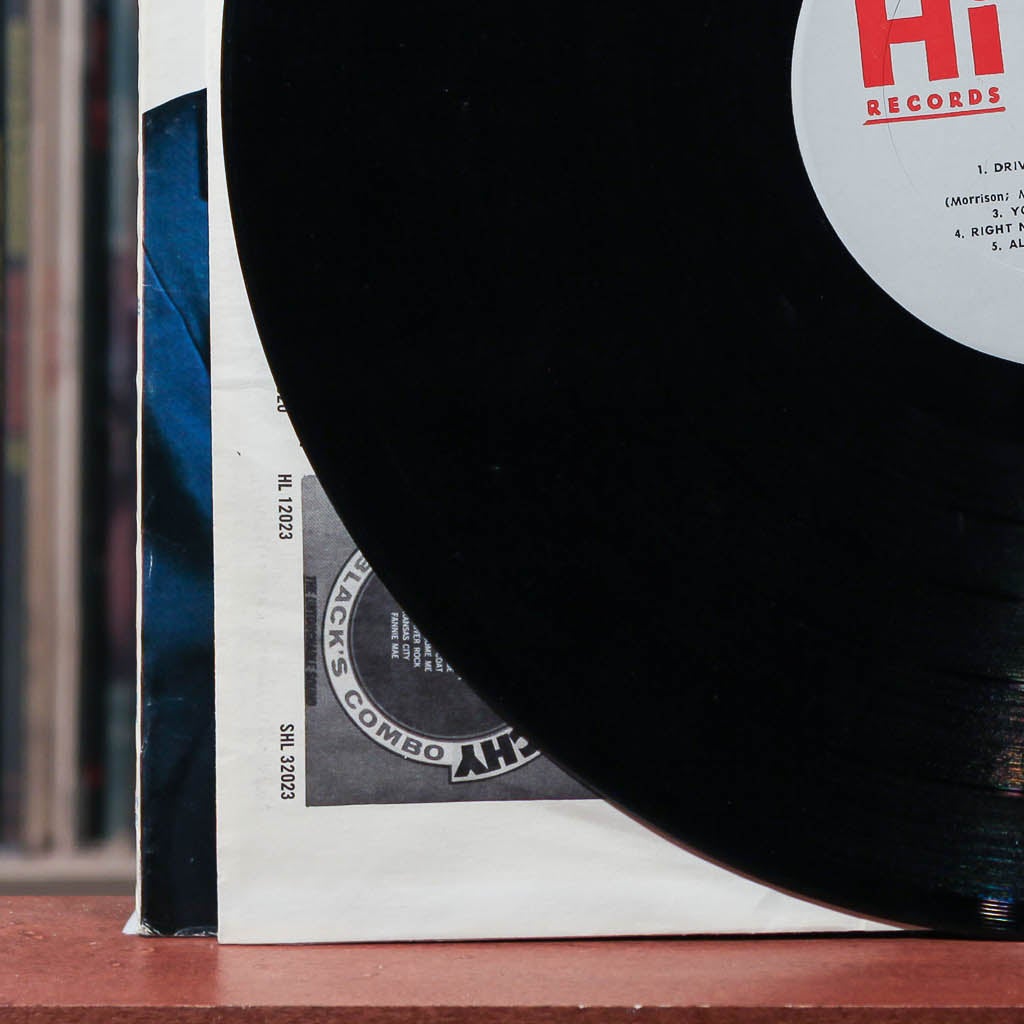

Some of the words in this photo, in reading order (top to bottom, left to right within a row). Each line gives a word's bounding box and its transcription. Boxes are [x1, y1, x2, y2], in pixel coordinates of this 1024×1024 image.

[866, 86, 1002, 117] RECORDS
[977, 165, 988, 175] 1.
[945, 192, 1009, 208] (Morrison;
[992, 209, 1003, 218] 3.
[955, 229, 965, 239] 4.
[971, 224, 1012, 237] RIGHT
[992, 242, 1002, 251] 5.
[277, 474, 291, 492] HL
[278, 496, 293, 541] 12023
[390, 612, 399, 640] FANNIE
[391, 643, 399, 660] MAE
[402, 643, 410, 661] CITY
[413, 647, 421, 668] ROCK
[424, 660, 432, 672] ME
[344, 689, 445, 761] COMBO
[279, 723, 294, 749] SHL
[279, 754, 295, 801] 32023
